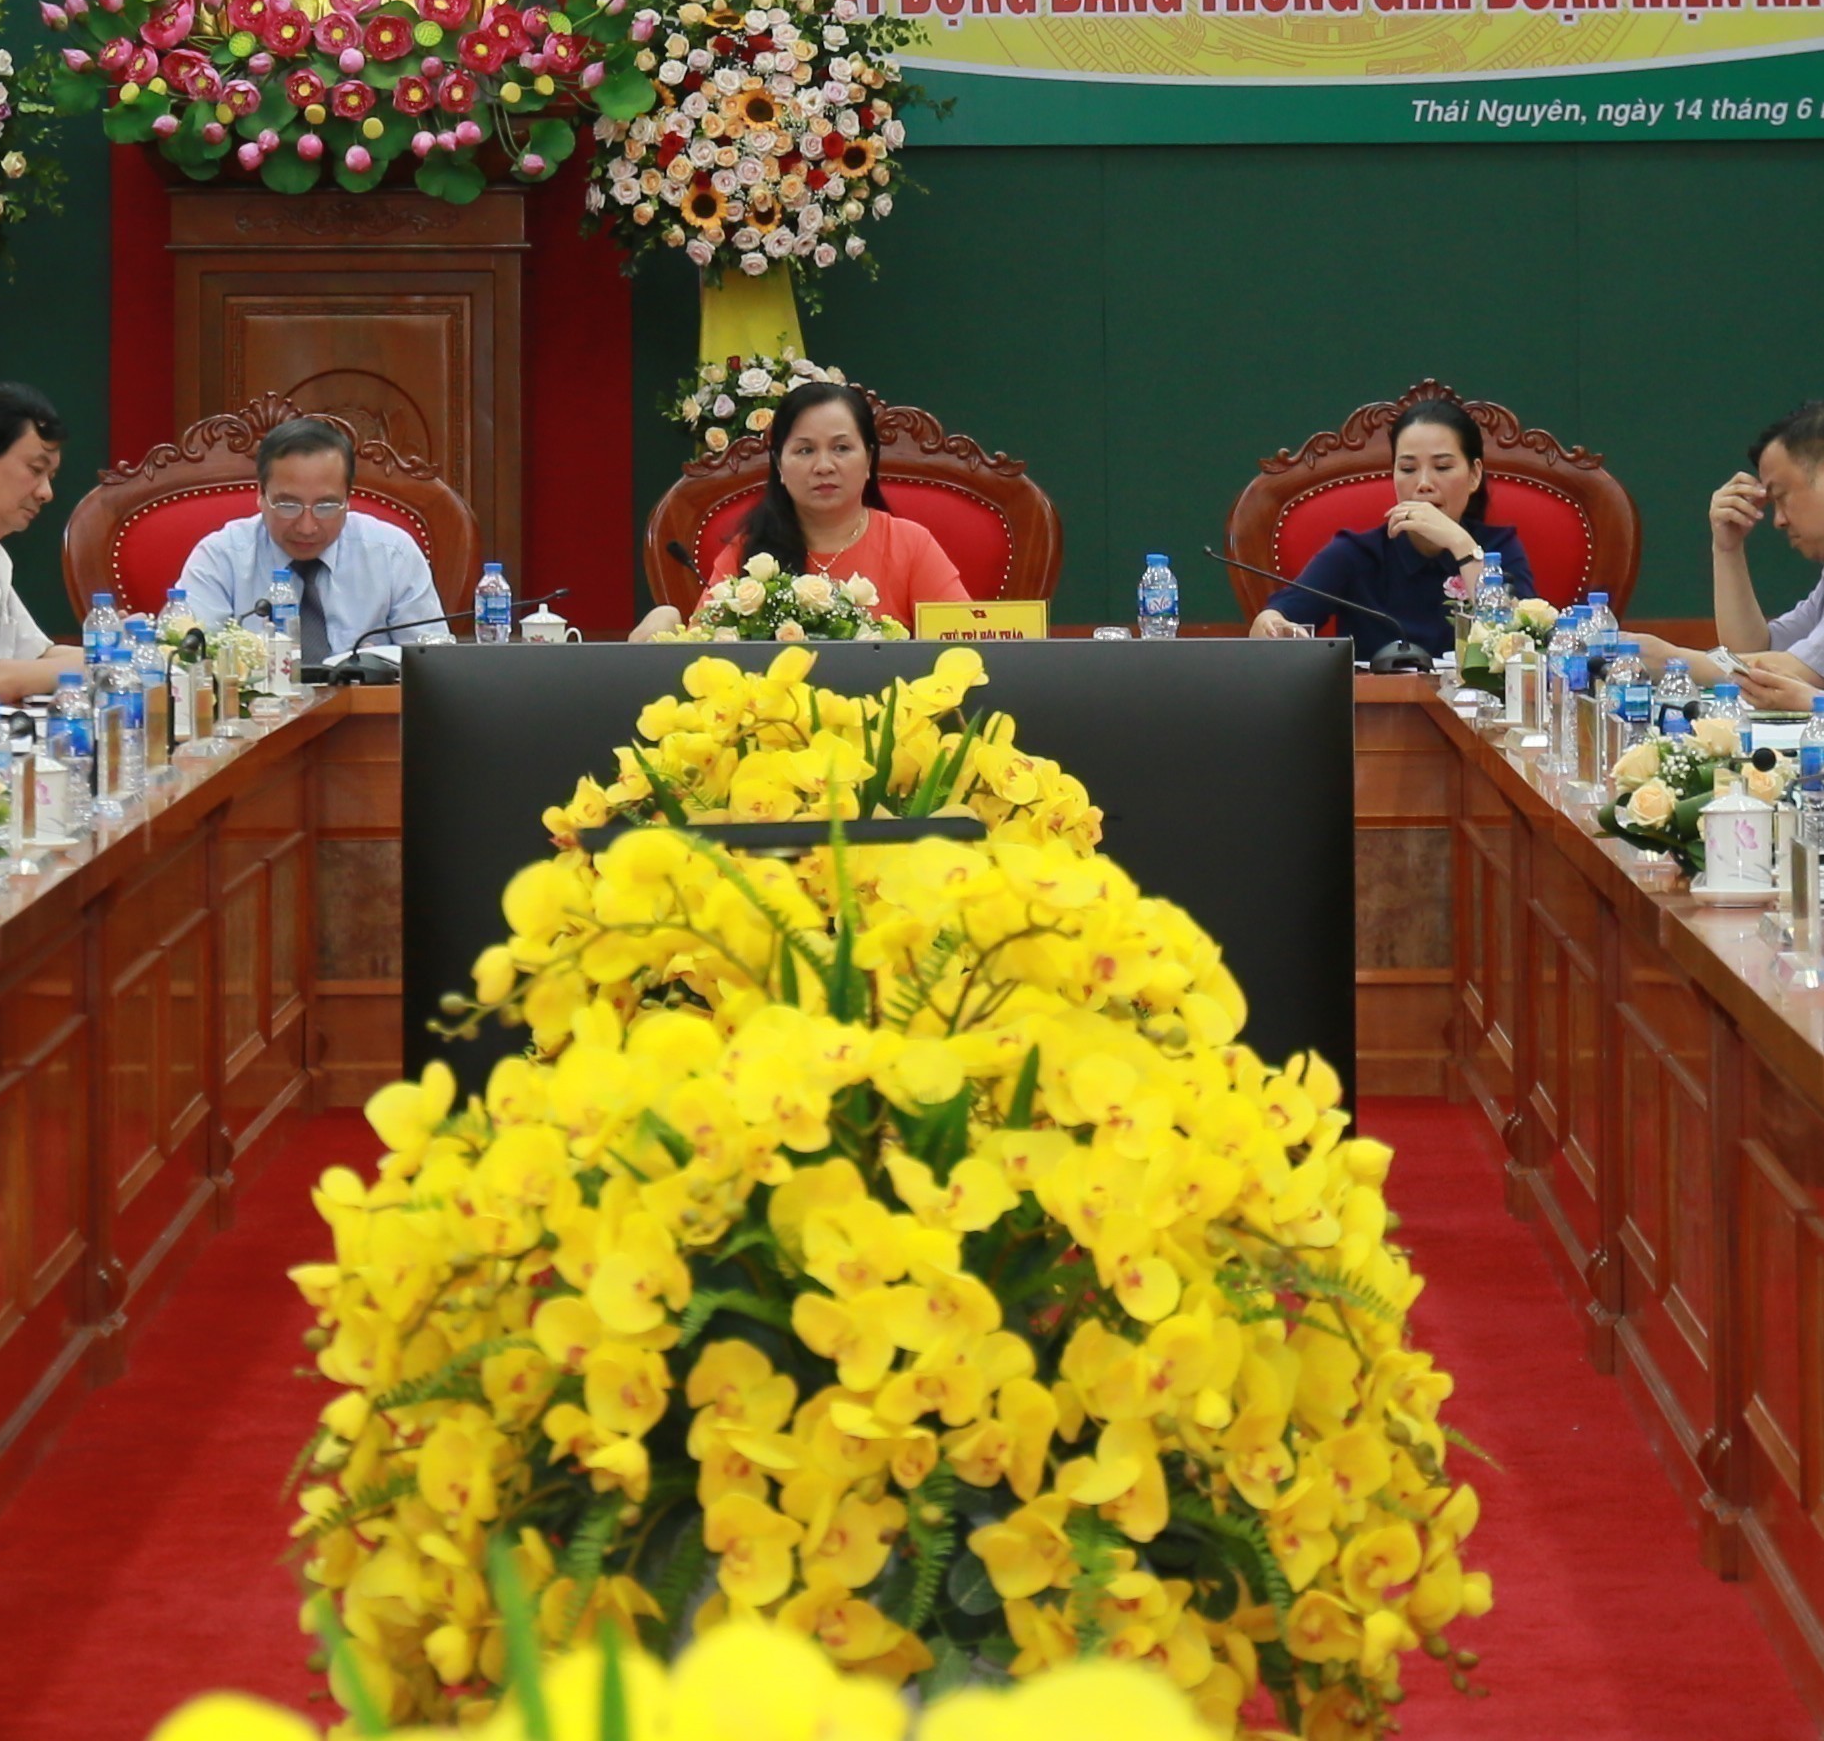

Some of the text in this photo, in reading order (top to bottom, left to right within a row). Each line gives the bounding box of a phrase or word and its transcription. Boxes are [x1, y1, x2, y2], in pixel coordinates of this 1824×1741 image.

[1411, 97, 1470, 125] Thái
[1476, 97, 1588, 134] Nguyên,
[1596, 99, 1664, 134] ngày
[1673, 99, 1704, 122] 14
[1710, 97, 1789, 129] tháng
[1796, 98, 1813, 121] 6
